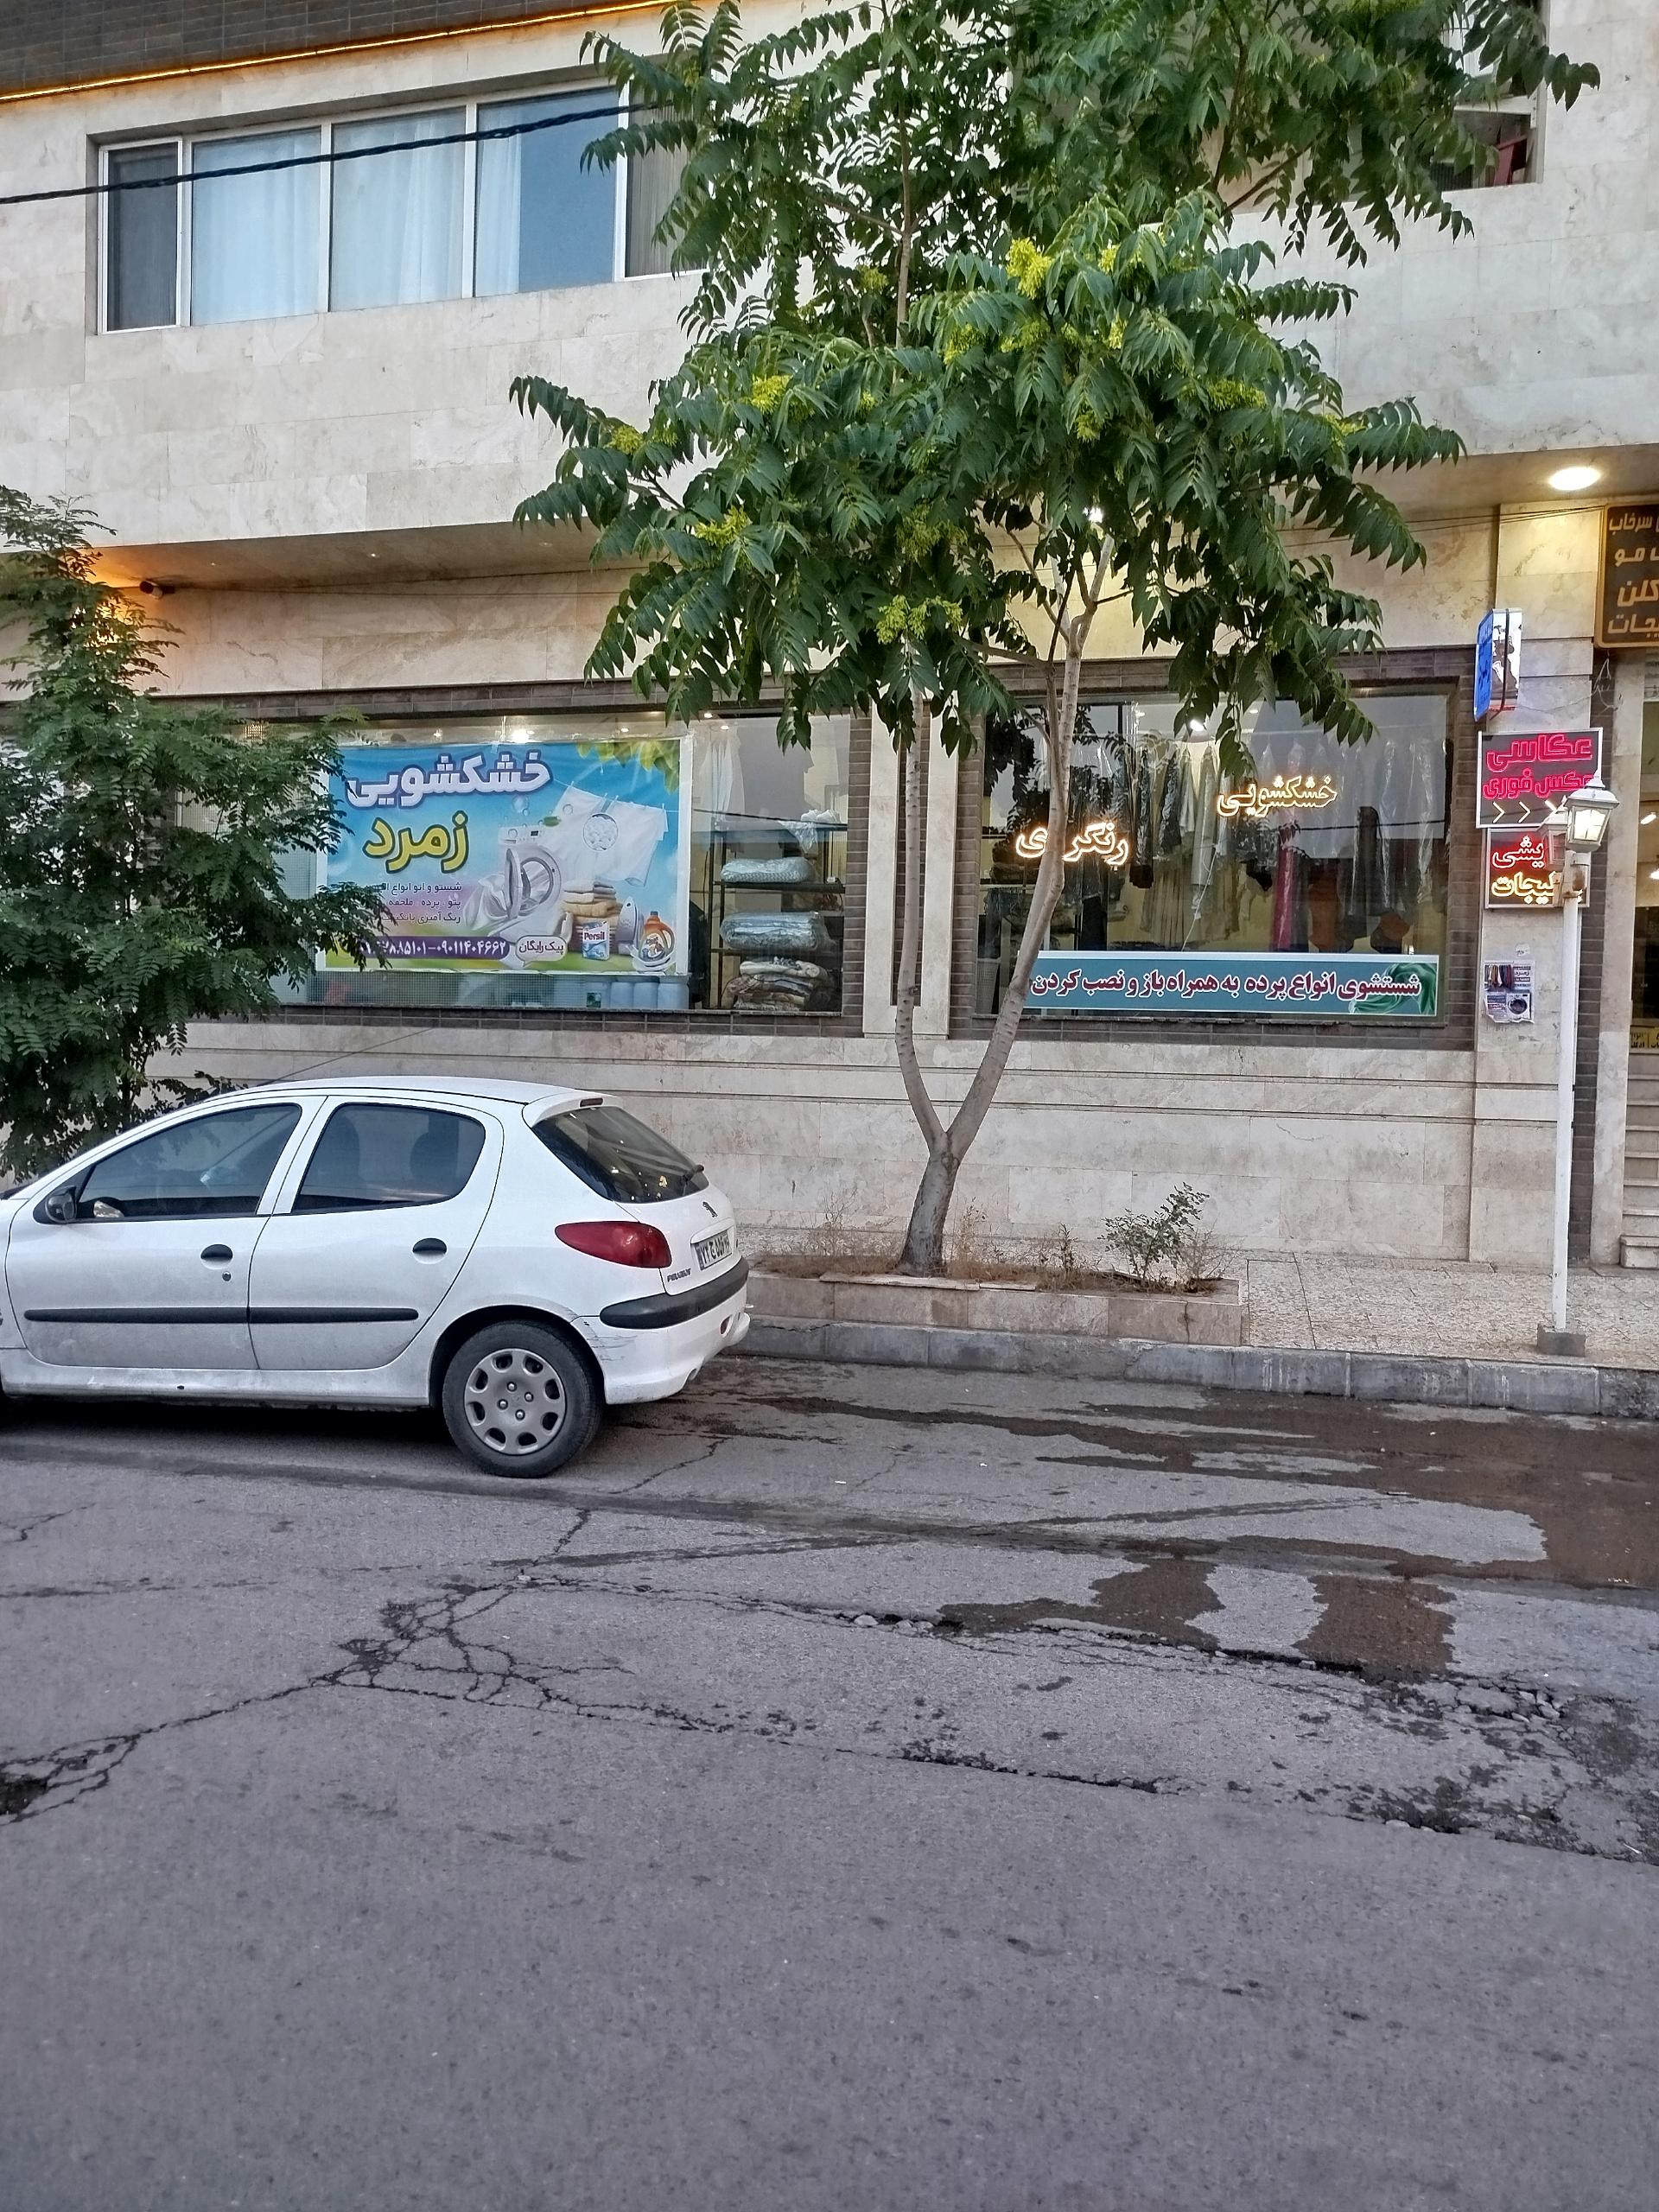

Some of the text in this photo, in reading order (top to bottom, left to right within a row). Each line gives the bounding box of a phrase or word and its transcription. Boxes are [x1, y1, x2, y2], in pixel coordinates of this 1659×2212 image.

[1486, 733, 1593, 772] عکاسی
[347, 751, 553, 807] خشکشویی
[1217, 775, 1338, 817] خشکشویی
[1483, 767, 1534, 799] فوری
[362, 810, 470, 873] زمرد
[1016, 820, 1128, 865] رنگری
[519, 940, 564, 955] پیک رایگان
[583, 931, 606, 941] Persil
[1031, 969, 1421, 1001] شستشوی انواع پرده به همراه باز و نصب کردن
